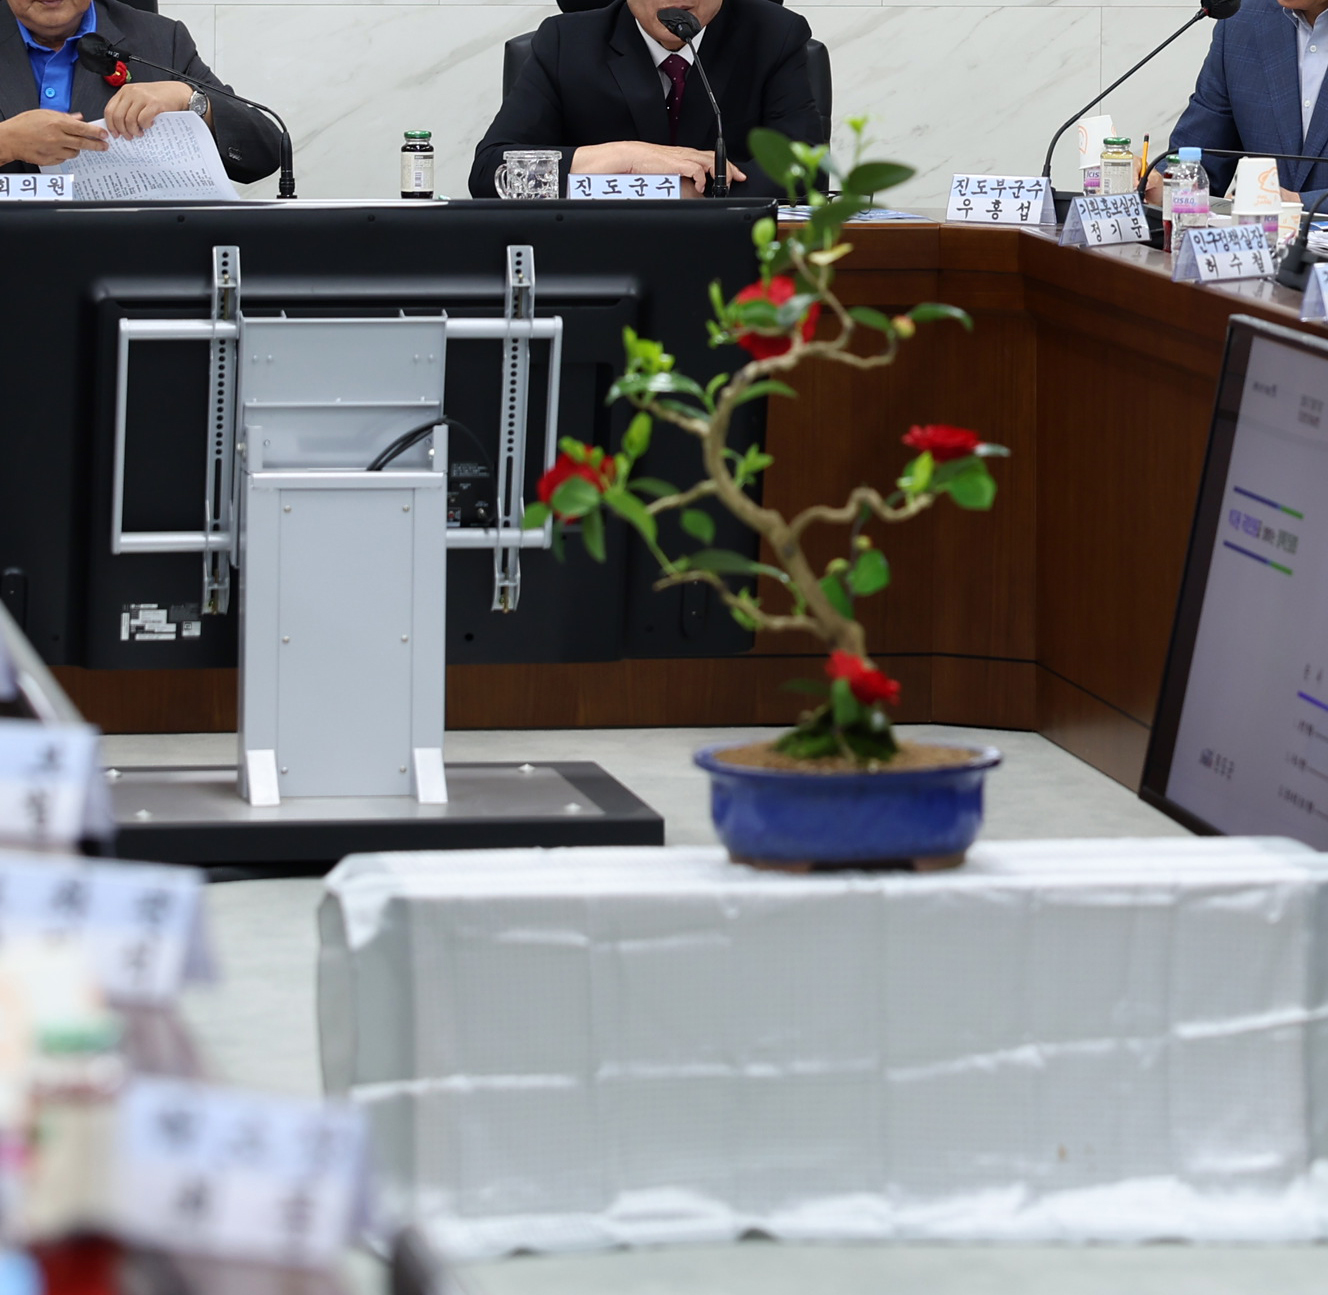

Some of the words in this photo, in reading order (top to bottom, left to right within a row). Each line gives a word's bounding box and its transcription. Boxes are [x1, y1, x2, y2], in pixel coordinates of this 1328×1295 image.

[574, 176, 676, 197] 진도군수
[953, 176, 1044, 201] 진도부군수
[1080, 194, 1141, 221] 기획홍보실장
[1193, 227, 1265, 253] 인구정책실장
